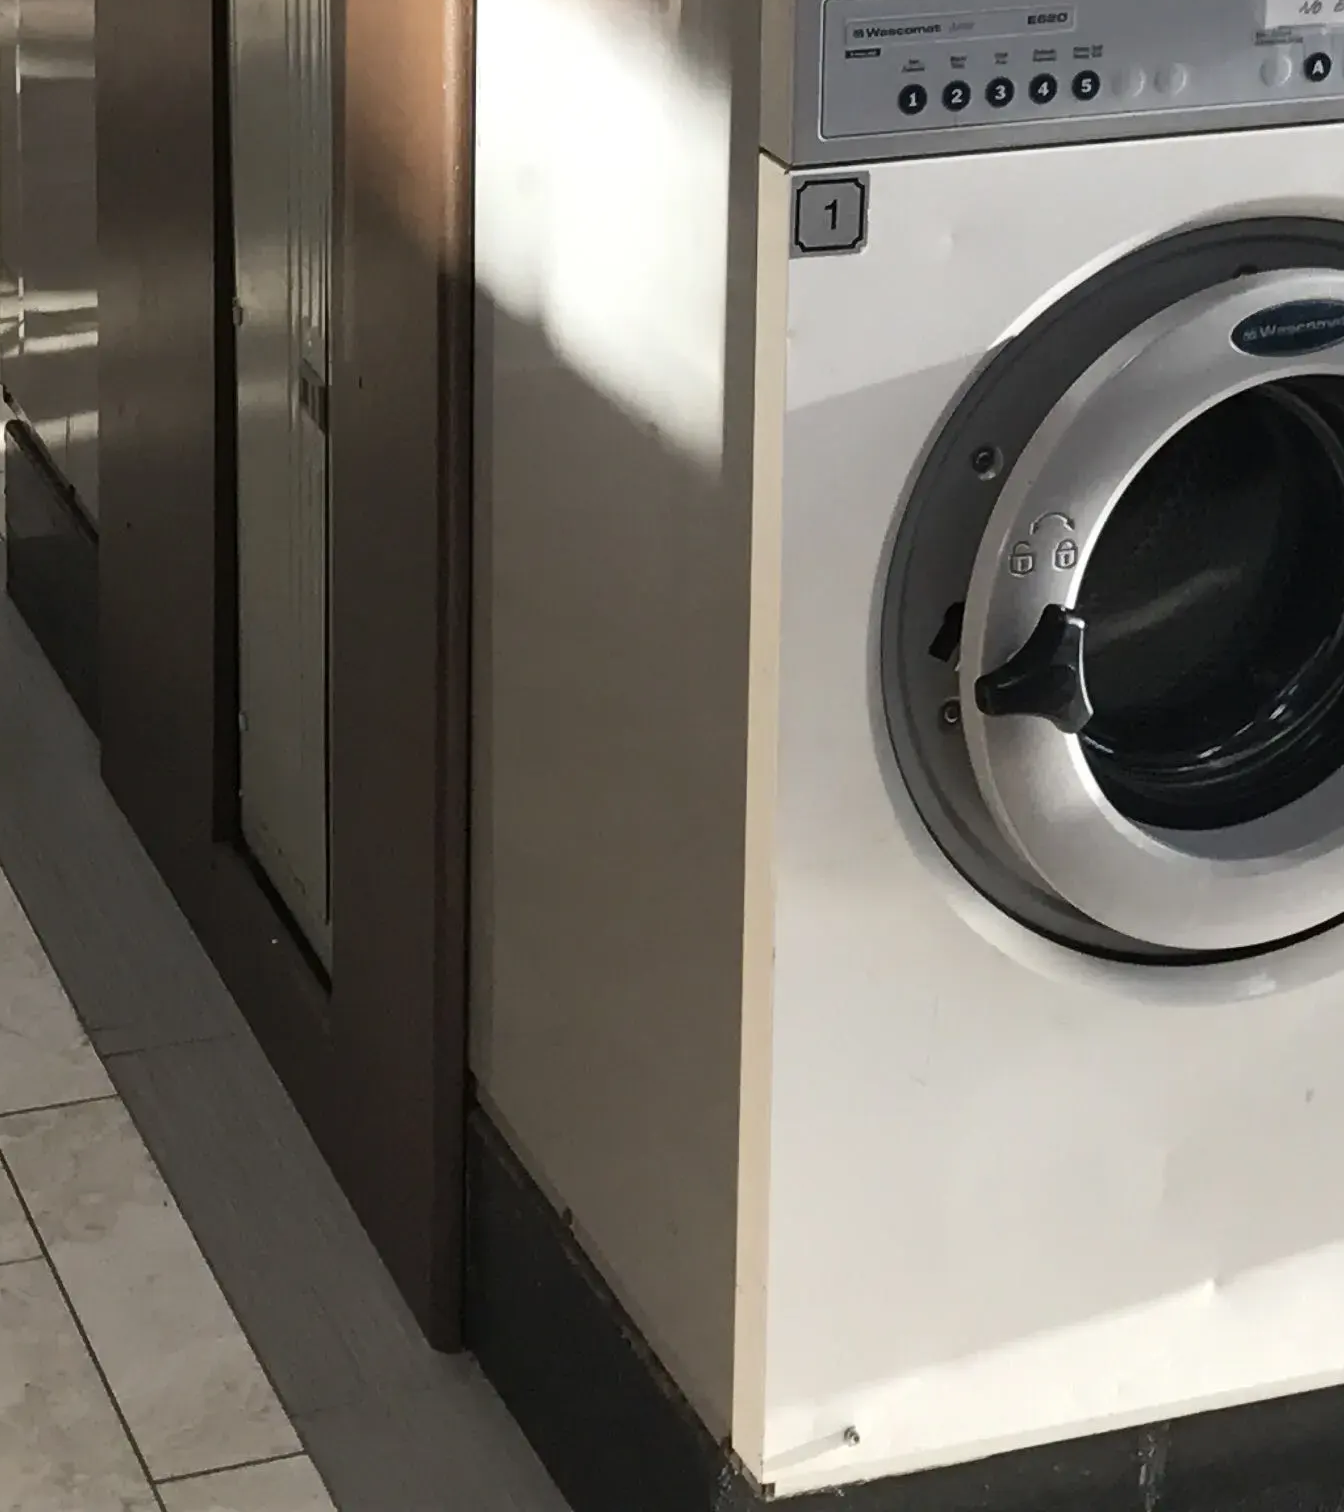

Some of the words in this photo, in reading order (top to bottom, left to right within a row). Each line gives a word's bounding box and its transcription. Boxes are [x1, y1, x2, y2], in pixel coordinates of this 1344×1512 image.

[866, 23, 941, 38] Wascomat
[1027, 12, 1068, 26] E620
[1312, 59, 1325, 75] A
[908, 93, 917, 108] 1
[951, 88, 962, 104] 2
[995, 84, 1006, 100] 3
[1037, 81, 1049, 97] 4
[1080, 77, 1092, 93] 5
[824, 198, 838, 230] 1
